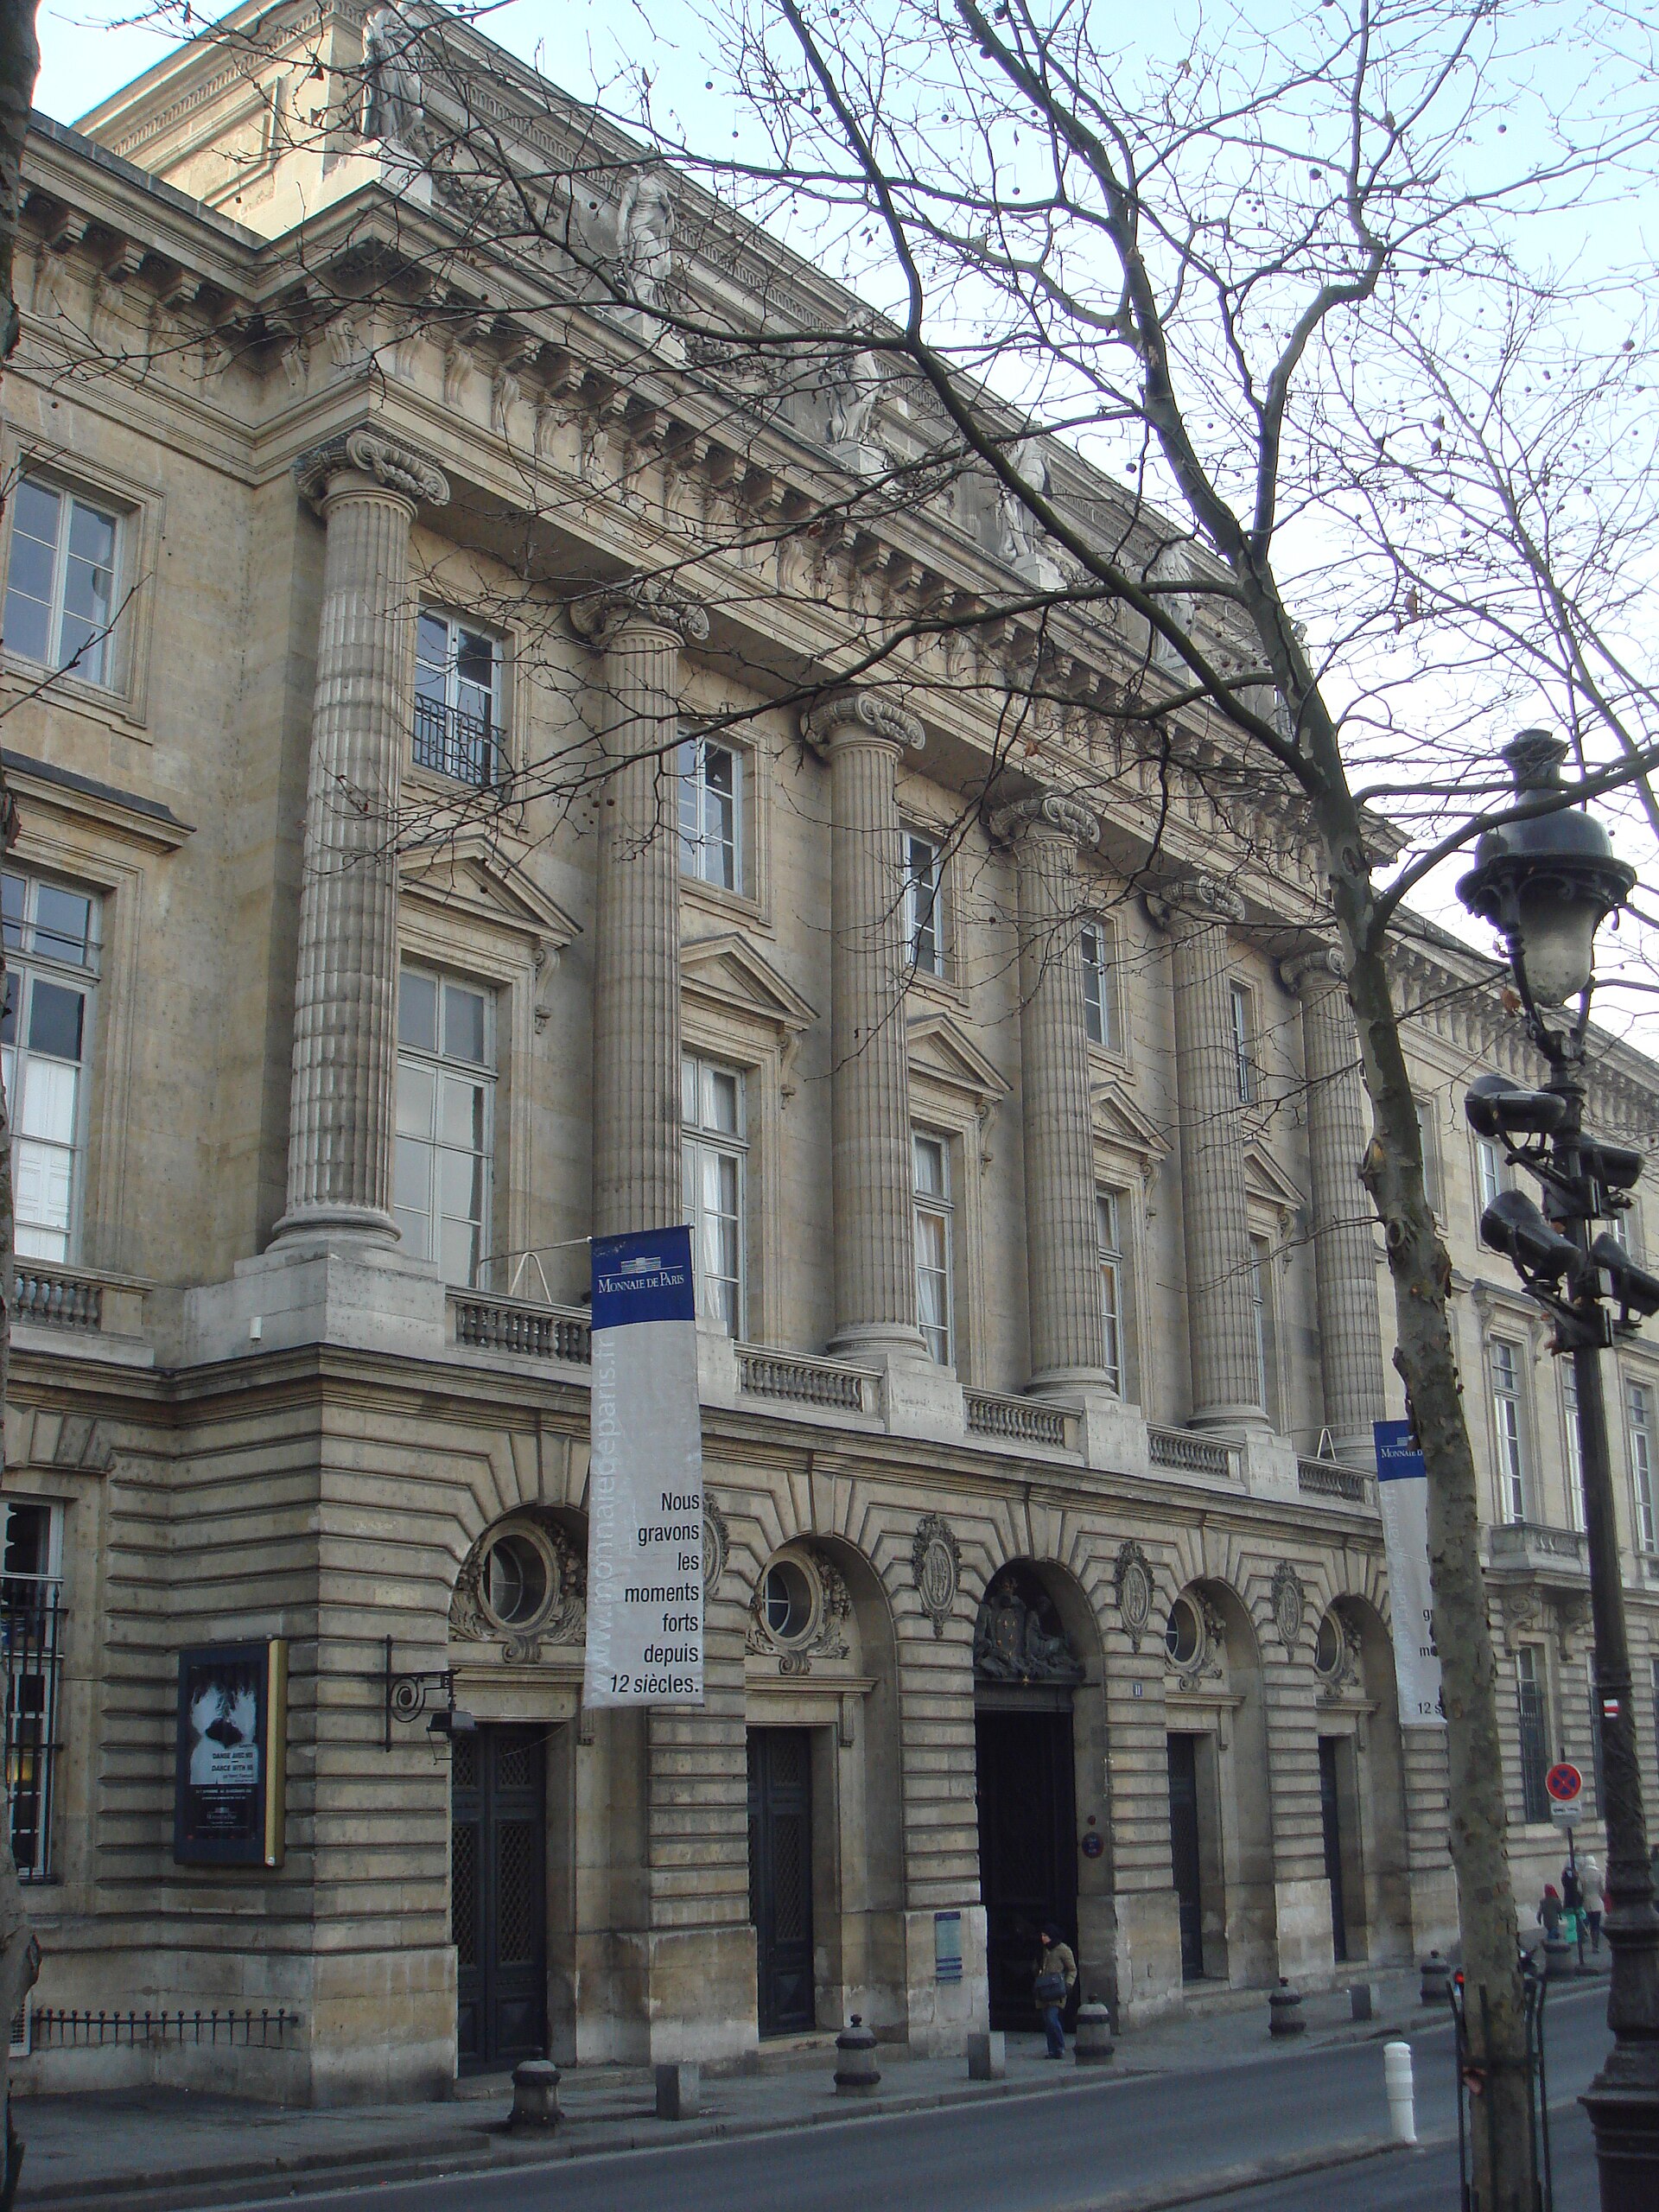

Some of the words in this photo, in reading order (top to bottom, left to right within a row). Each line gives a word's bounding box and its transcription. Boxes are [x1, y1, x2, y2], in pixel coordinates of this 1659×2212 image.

[598, 1278, 645, 1294] MONNAIE
[646, 1277, 659, 1288] DE
[659, 1272, 684, 1287] PARIS
[662, 1492, 700, 1511] Nous
[639, 1524, 699, 1547] gravons
[677, 1552, 699, 1571] les
[625, 1582, 699, 1603] moments
[662, 1613, 698, 1632] forts
[644, 1643, 698, 1667] depuis
[611, 1674, 629, 1693] 12
[633, 1674, 699, 1693] siècles.
[1419, 1701, 1431, 1714] 12
